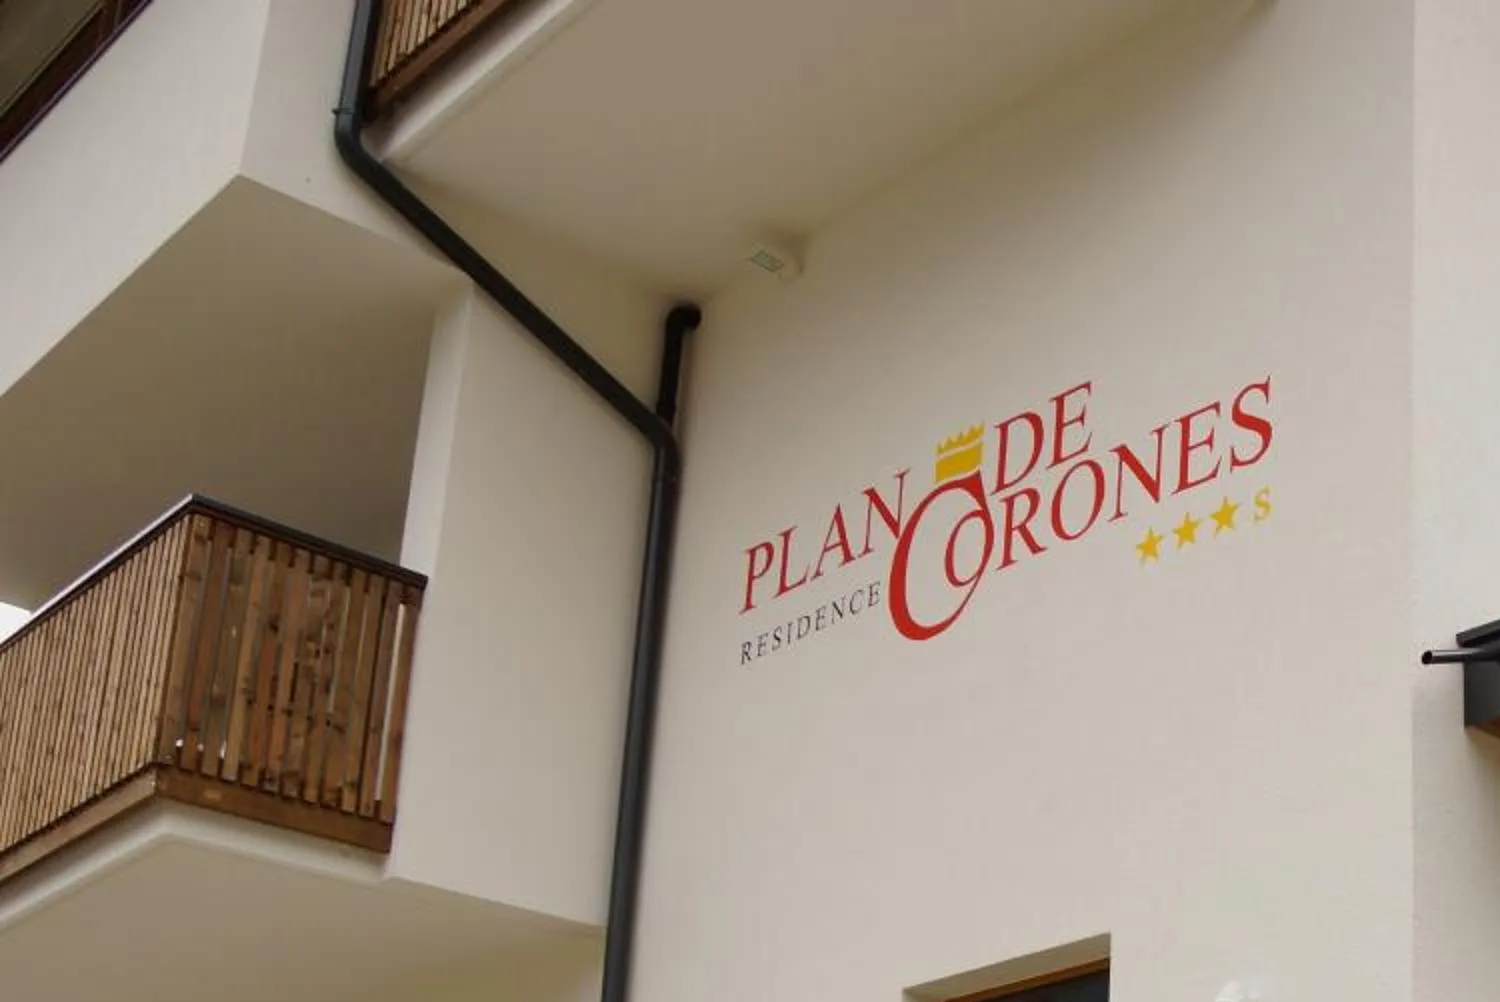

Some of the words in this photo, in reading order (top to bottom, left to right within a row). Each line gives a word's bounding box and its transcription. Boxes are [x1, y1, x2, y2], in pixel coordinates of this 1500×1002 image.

[738, 467, 910, 615] PLAN
[990, 381, 1093, 495] DE
[888, 376, 1274, 641] CORONES
[1252, 486, 1275, 523] S
[740, 581, 881, 666] RESIDENCE
